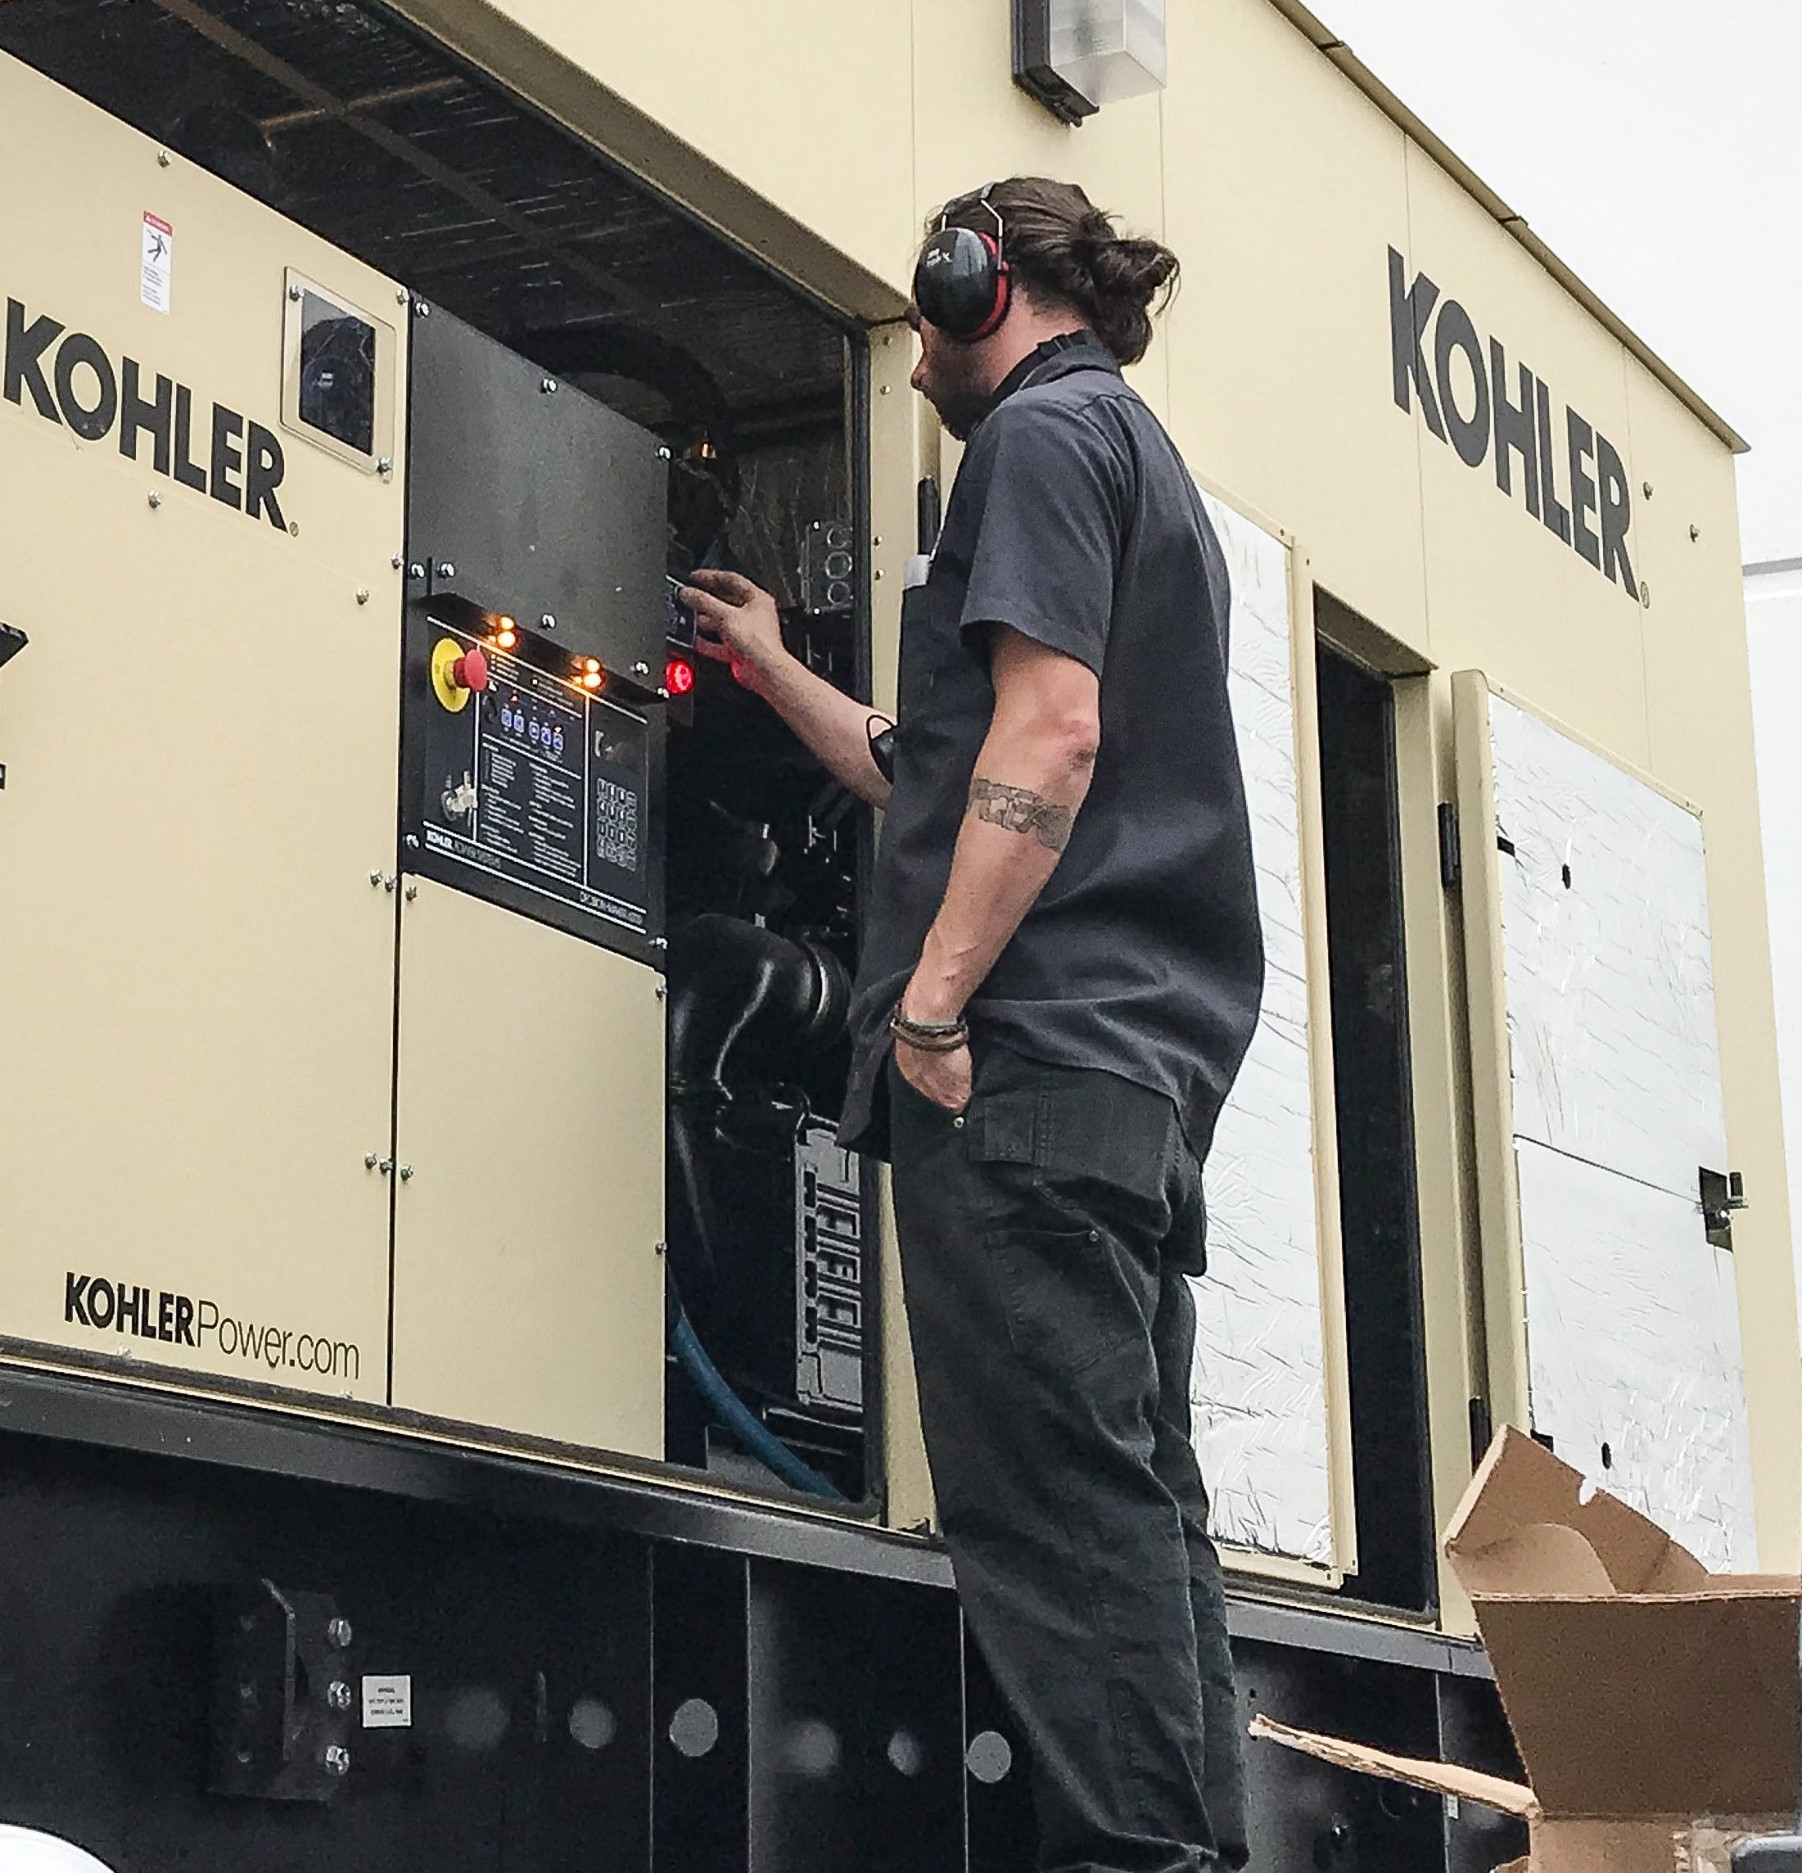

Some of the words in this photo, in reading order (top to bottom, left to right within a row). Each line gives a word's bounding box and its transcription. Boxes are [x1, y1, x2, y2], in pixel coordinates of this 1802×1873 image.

[4, 297, 288, 533] KOHLER
[1388, 244, 1640, 602] KOHLER
[64, 1271, 360, 1380] KOHLERPower.com
